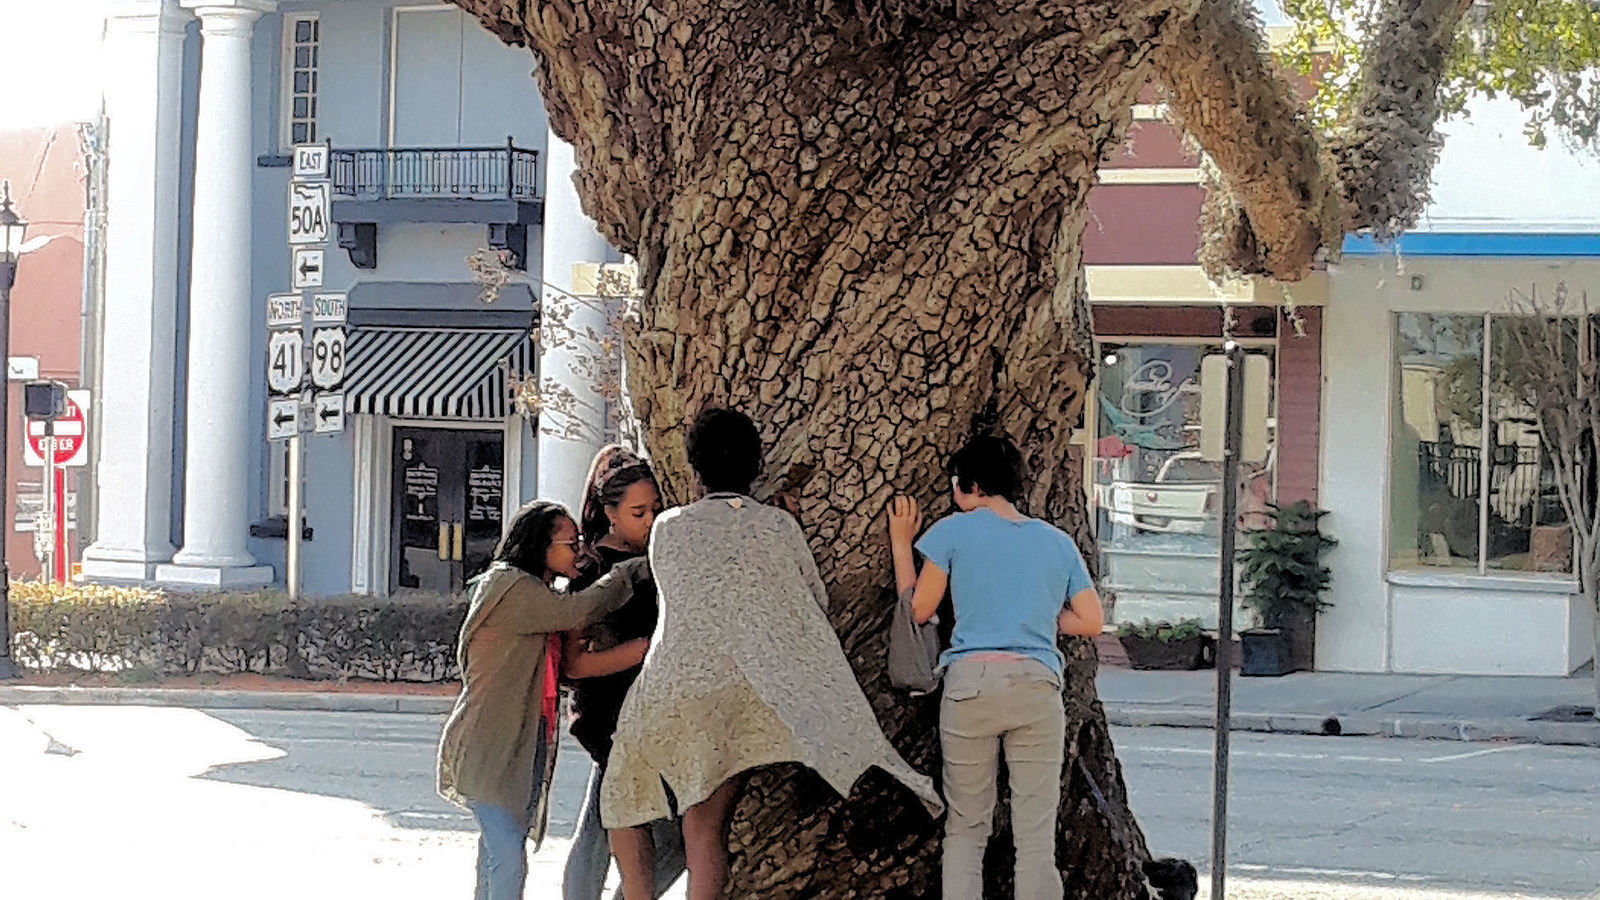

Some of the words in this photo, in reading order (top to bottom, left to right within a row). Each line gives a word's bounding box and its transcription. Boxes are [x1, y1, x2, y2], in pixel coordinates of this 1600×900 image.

[300, 151, 322, 170] EAST
[292, 205, 324, 234] 50A
[268, 300, 302, 319] NORTH
[315, 297, 344, 316] SOUTH
[273, 342, 296, 378] 41
[316, 340, 342, 373] 98
[38, 438, 74, 451] EER
